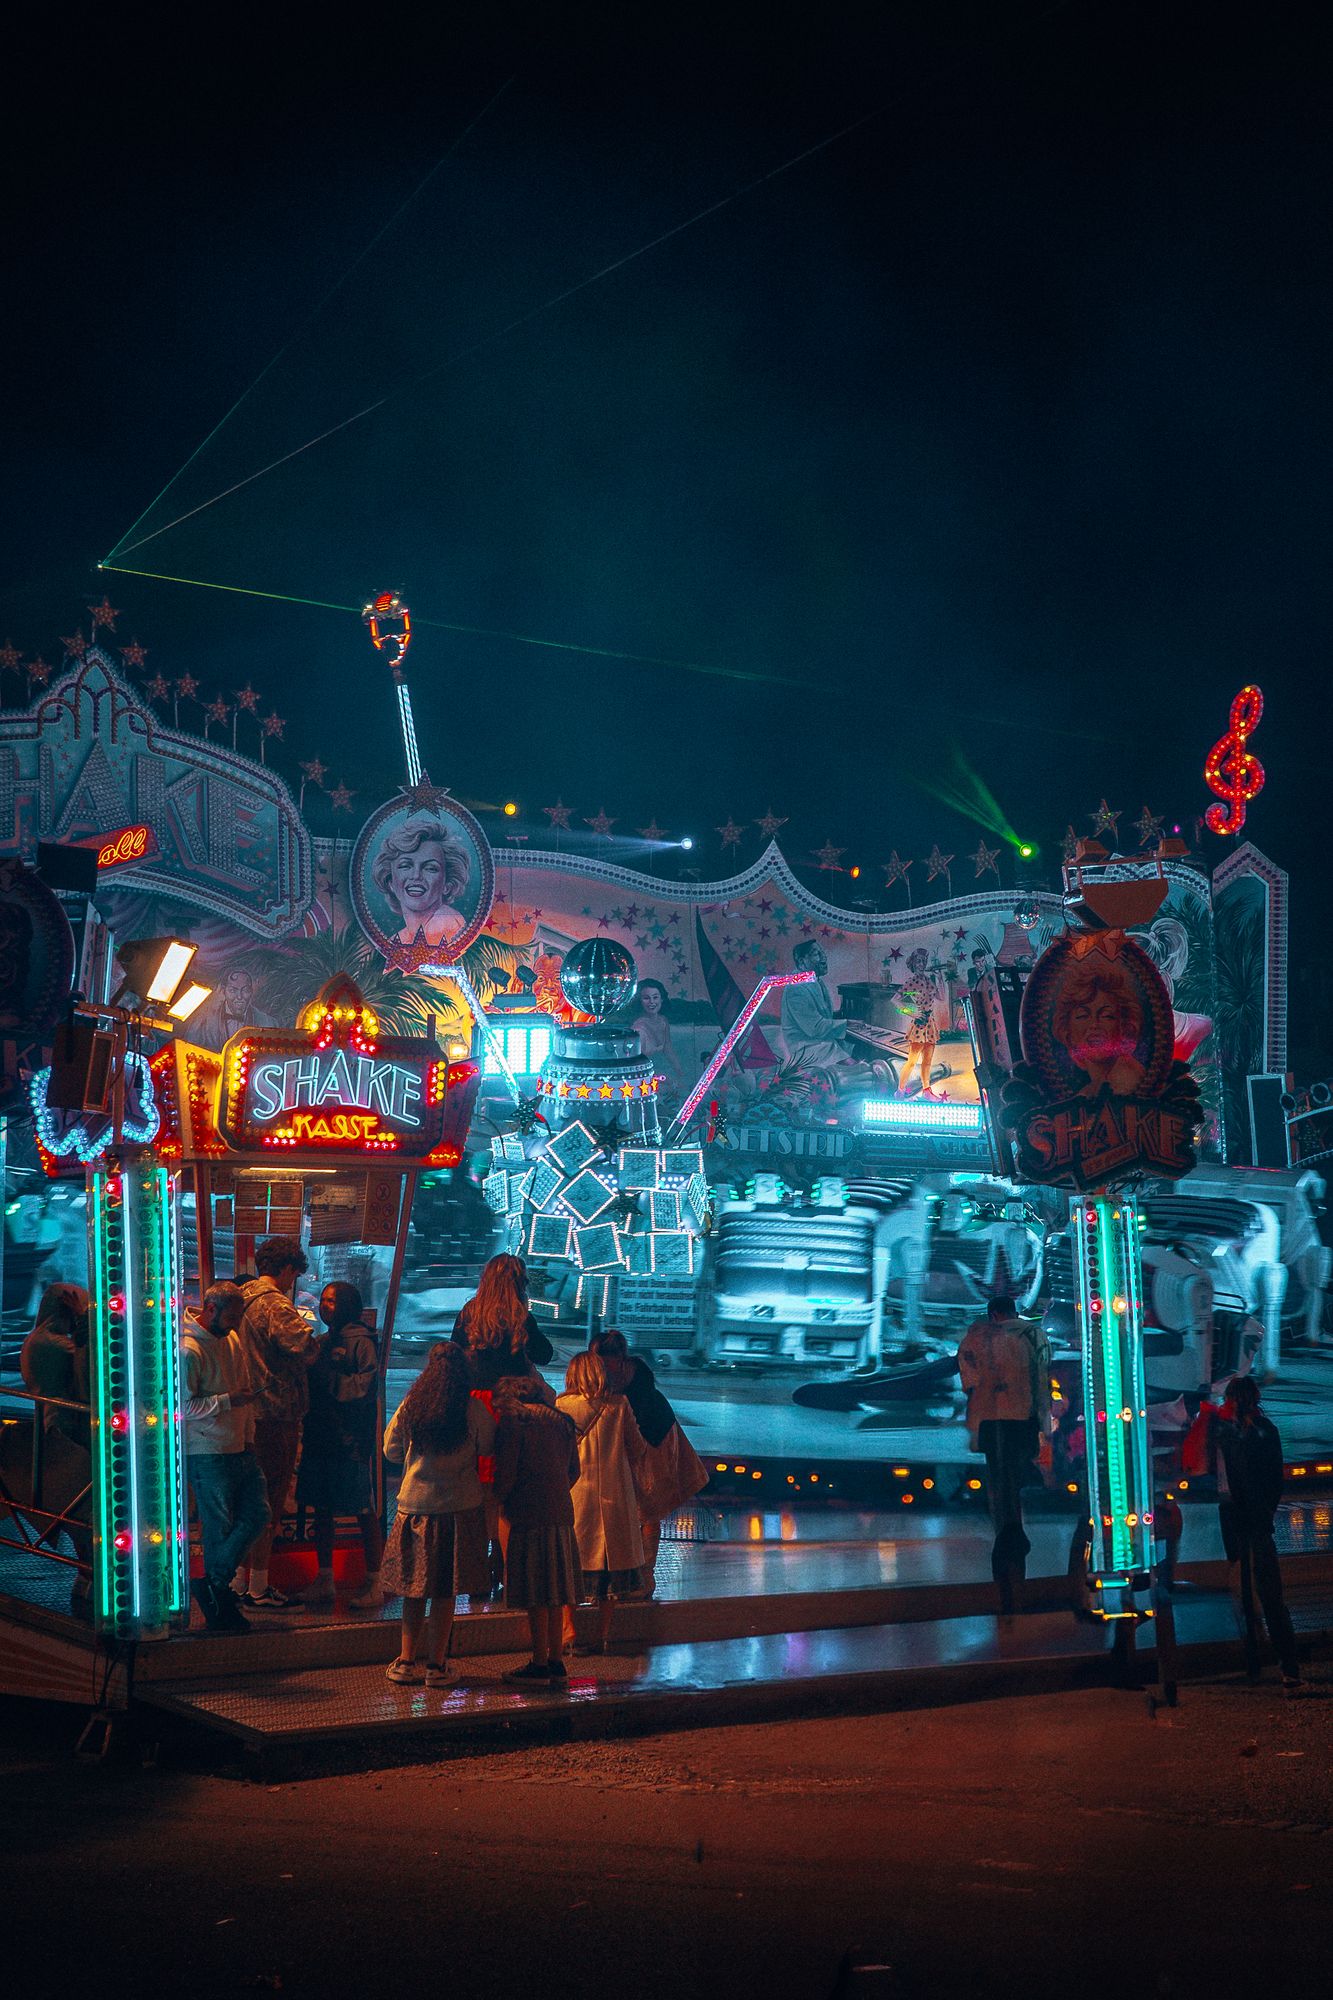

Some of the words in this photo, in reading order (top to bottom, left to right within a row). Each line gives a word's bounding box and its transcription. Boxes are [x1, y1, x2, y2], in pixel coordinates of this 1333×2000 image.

[0, 739, 270, 886] HAKE
[97, 828, 147, 865] oll
[253, 1049, 422, 1126] SHAKE
[293, 1113, 379, 1140] KASSE
[778, 1131, 853, 1157] STRIP
[1026, 1099, 1188, 1170] SHAKE
